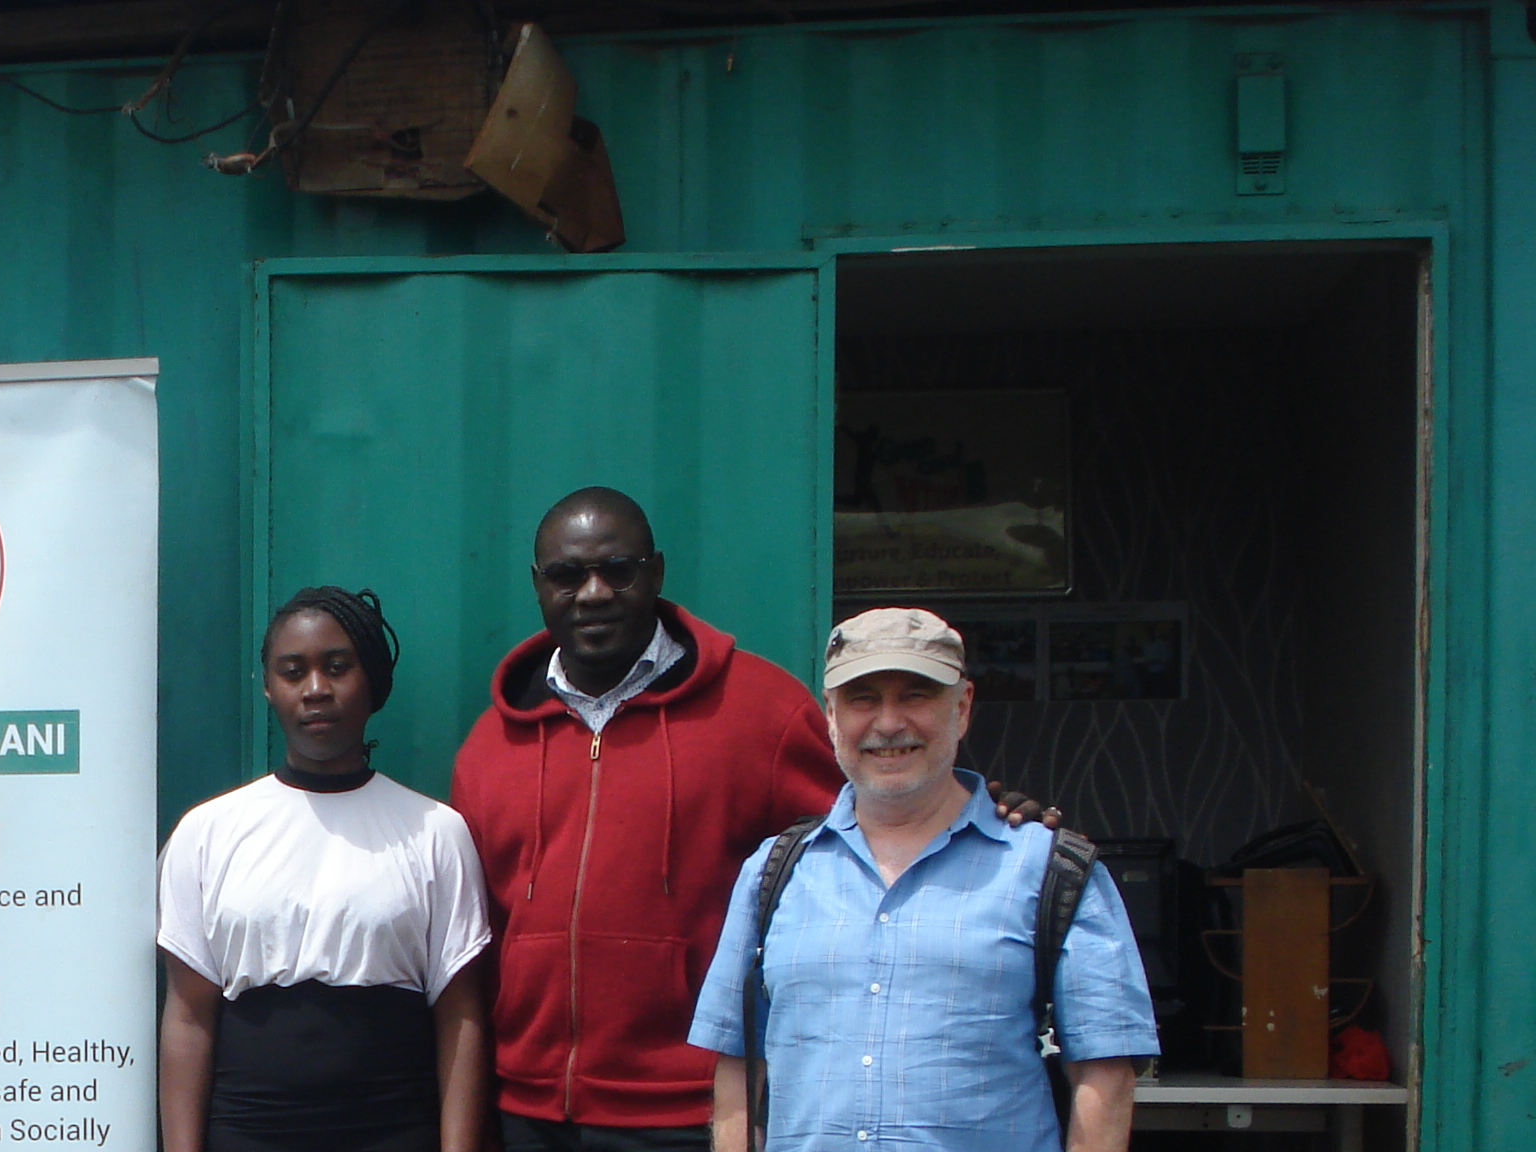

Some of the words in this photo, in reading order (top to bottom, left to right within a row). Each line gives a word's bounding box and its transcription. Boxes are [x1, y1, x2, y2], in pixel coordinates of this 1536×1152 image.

[835, 544, 901, 565] urture,
[35, 883, 81, 906] and
[33, 1040, 133, 1068] Healthy,
[51, 1079, 96, 1101] and
[11, 1118, 110, 1146] Socially
